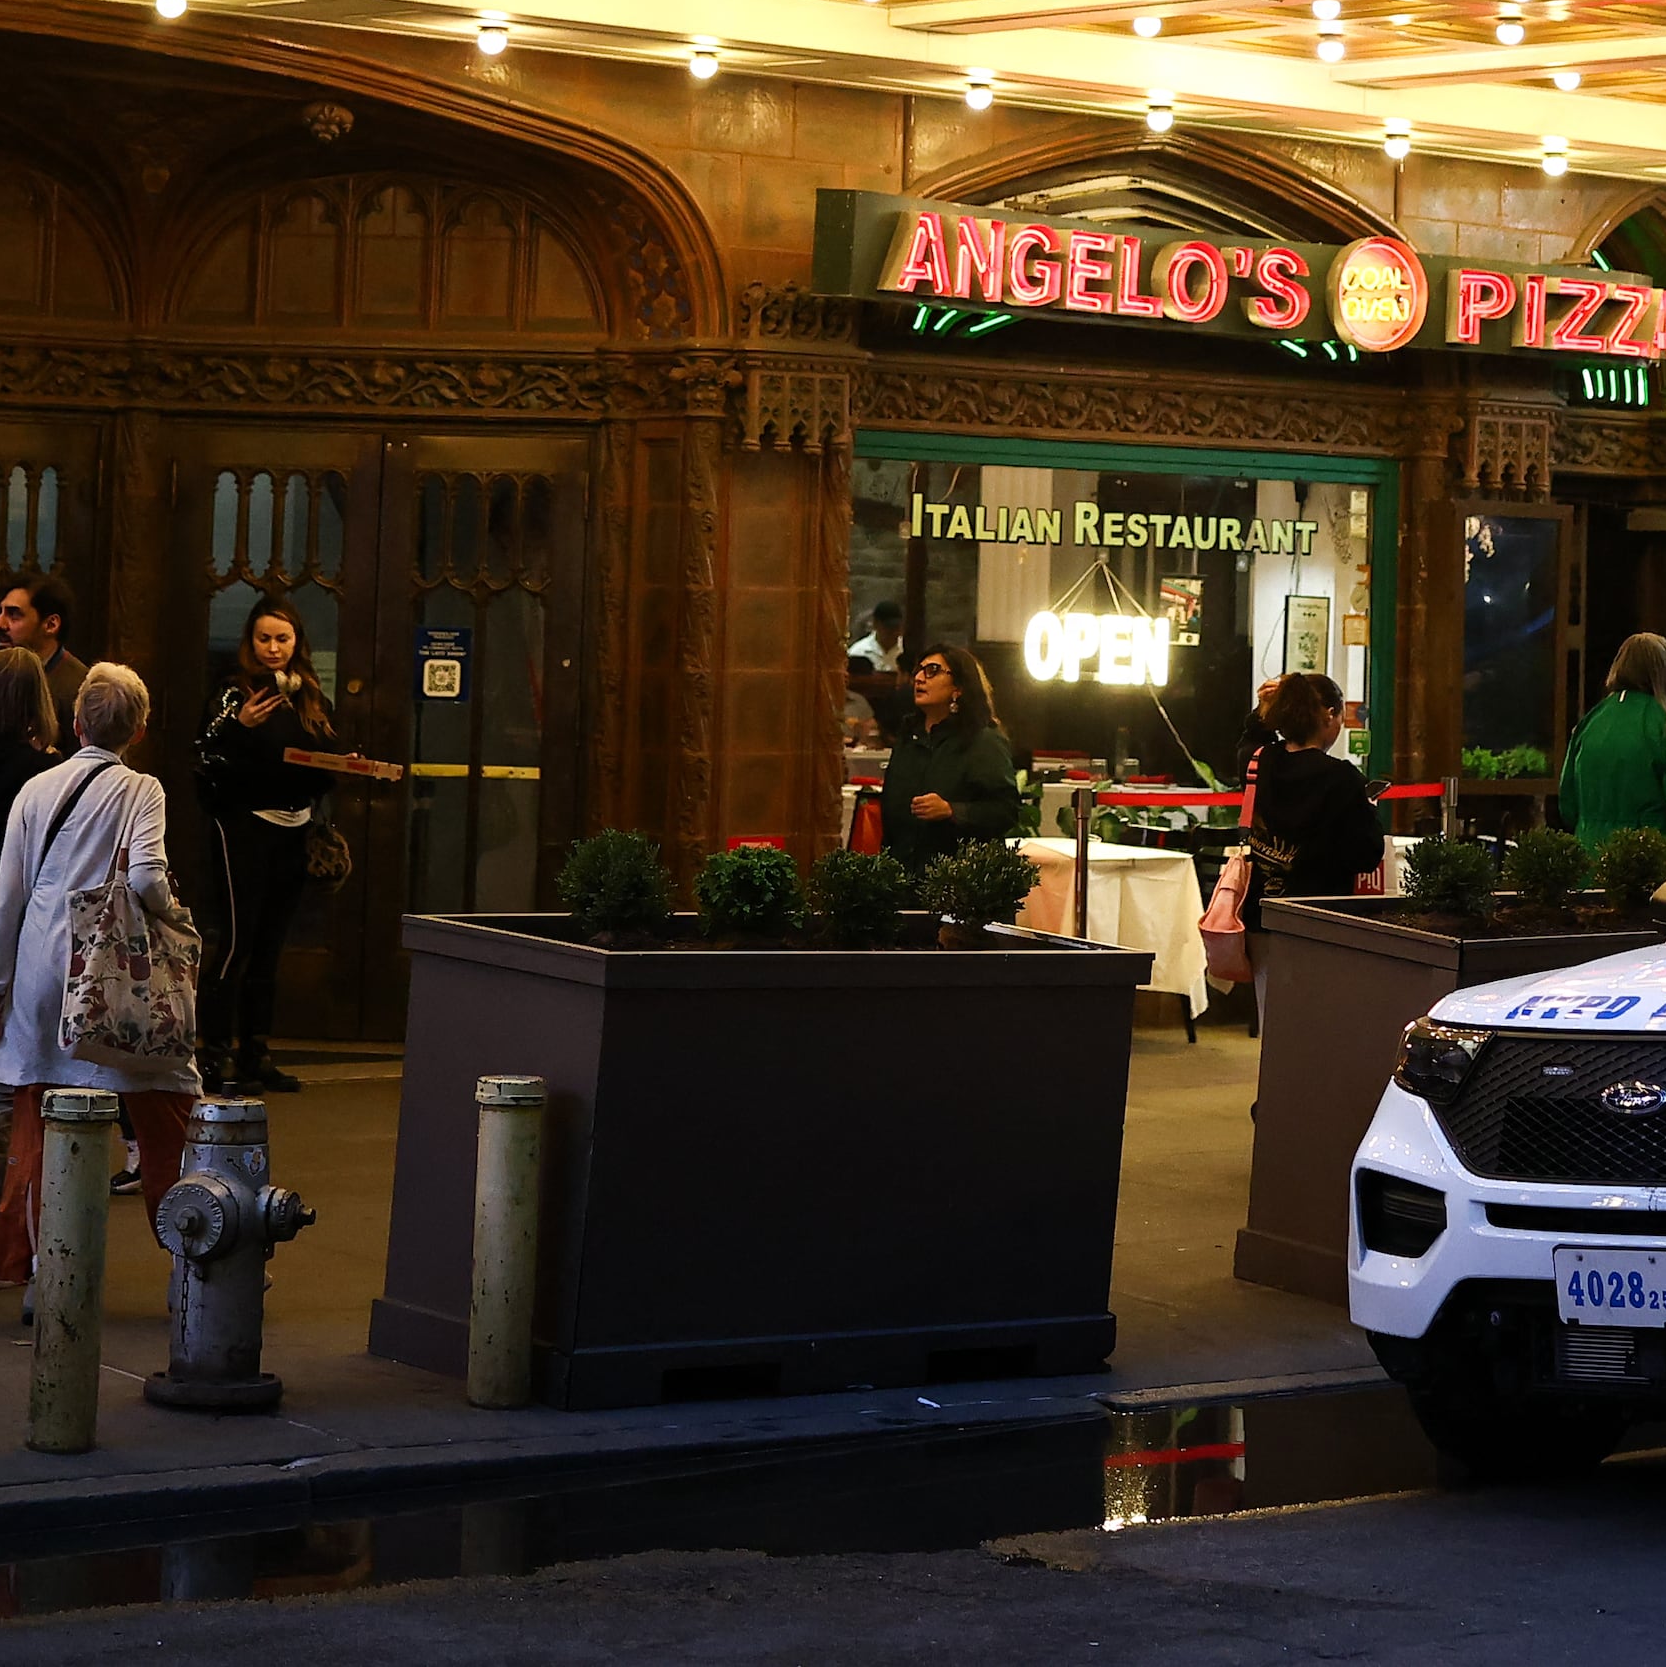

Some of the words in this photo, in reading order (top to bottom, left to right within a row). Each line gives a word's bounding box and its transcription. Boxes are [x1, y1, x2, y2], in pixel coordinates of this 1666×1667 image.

[895, 211, 1311, 330] ANGELO'S
[1341, 265, 1411, 291] COAL
[1341, 297, 1410, 322] OVEN
[911, 493, 1062, 546] ITALIAN
[1074, 501, 1318, 555] RESTAURANT
[1023, 610, 1171, 687] OPEN
[1505, 995, 1642, 1020] NYPD
[1567, 1270, 1646, 1309] 4028
